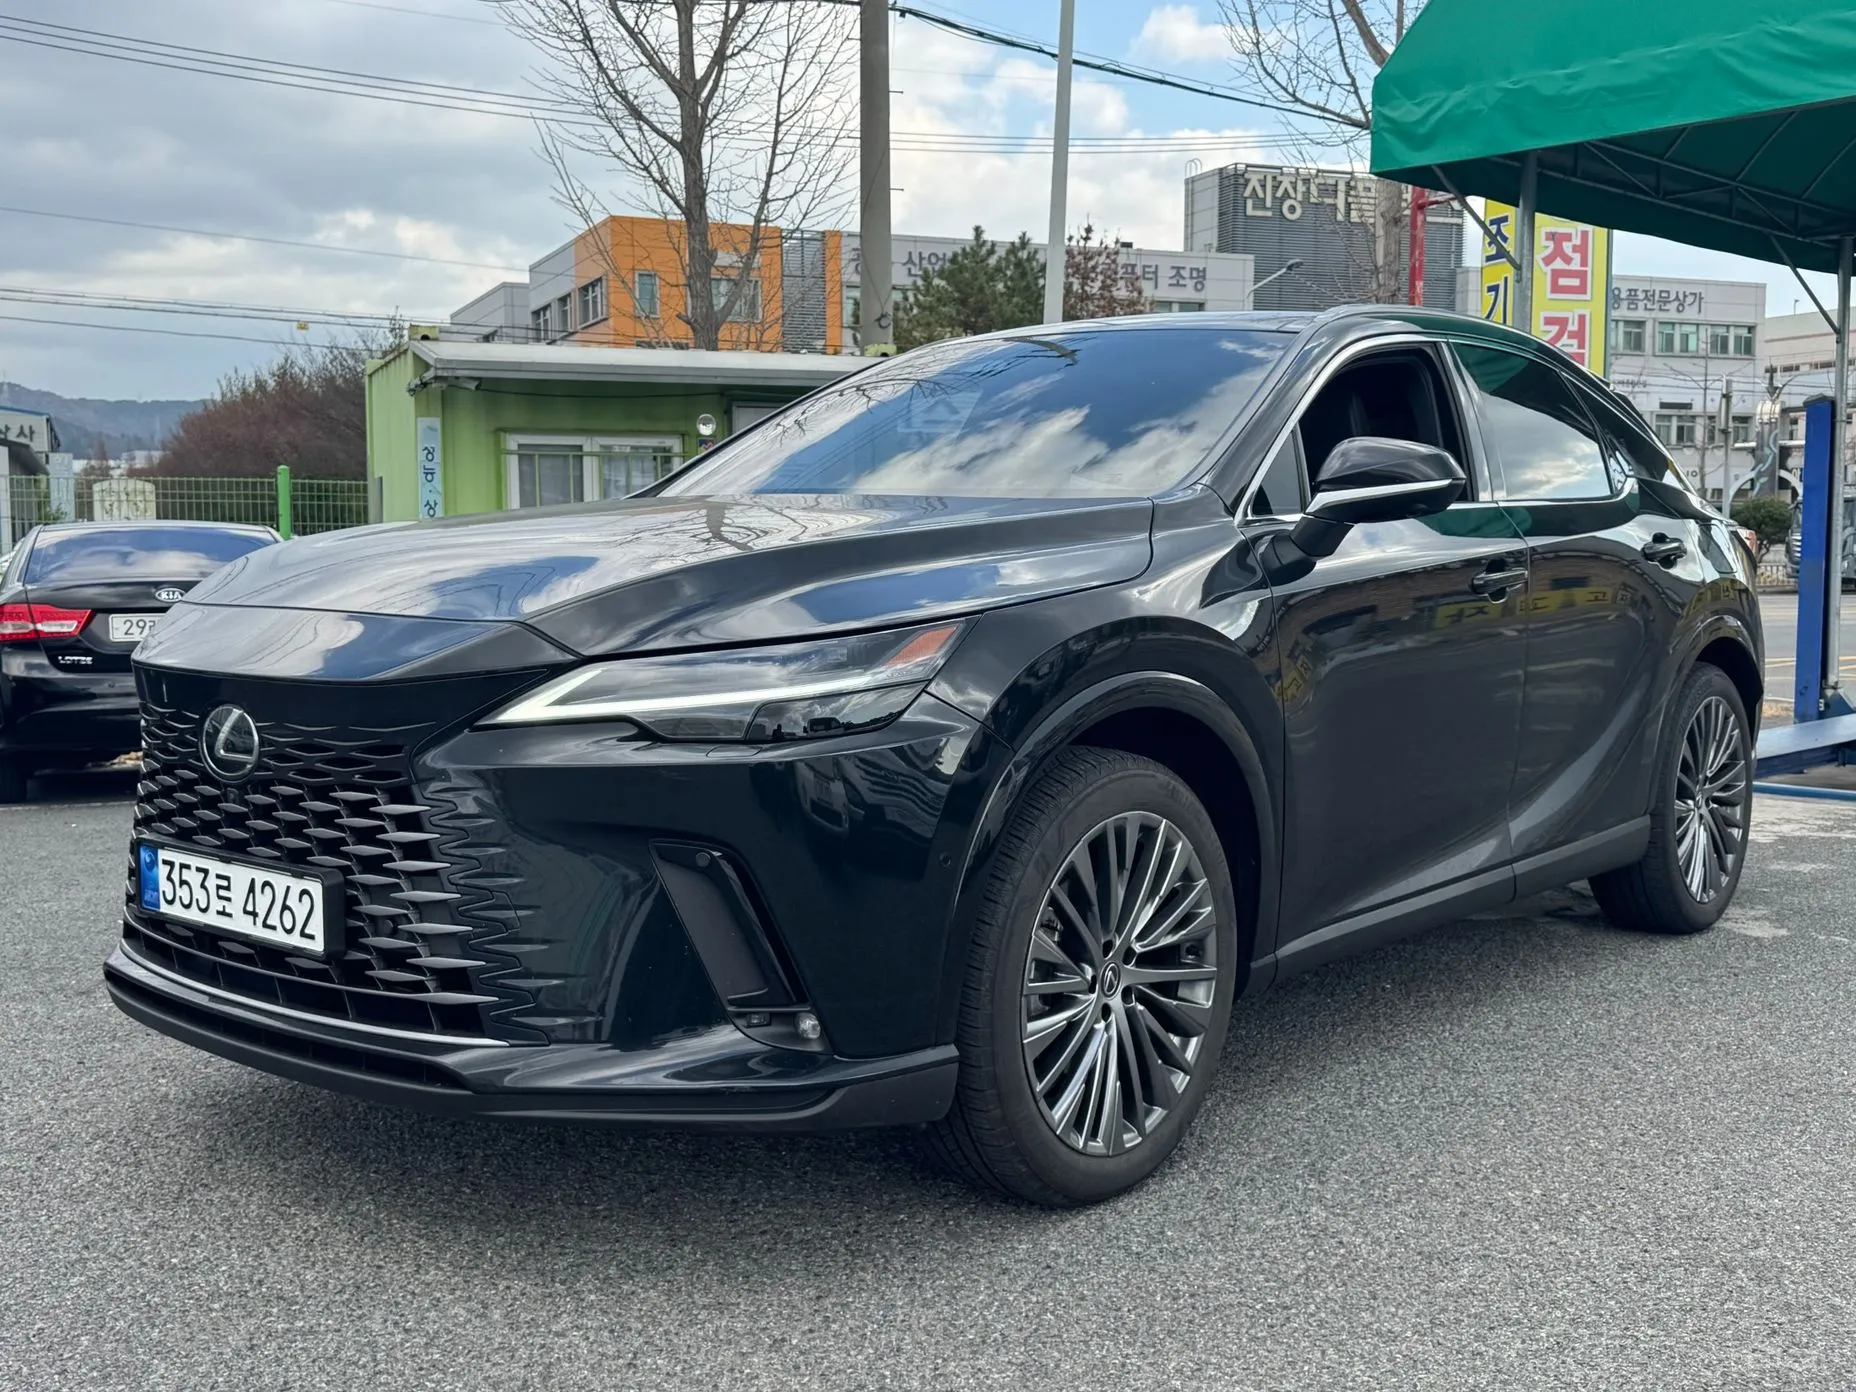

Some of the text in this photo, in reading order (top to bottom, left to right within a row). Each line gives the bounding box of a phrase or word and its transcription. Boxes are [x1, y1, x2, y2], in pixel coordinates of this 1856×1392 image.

[1168, 265, 1206, 292] 조명
[160, 591, 182, 600] KIA
[161, 858, 316, 941] 353로 4262
